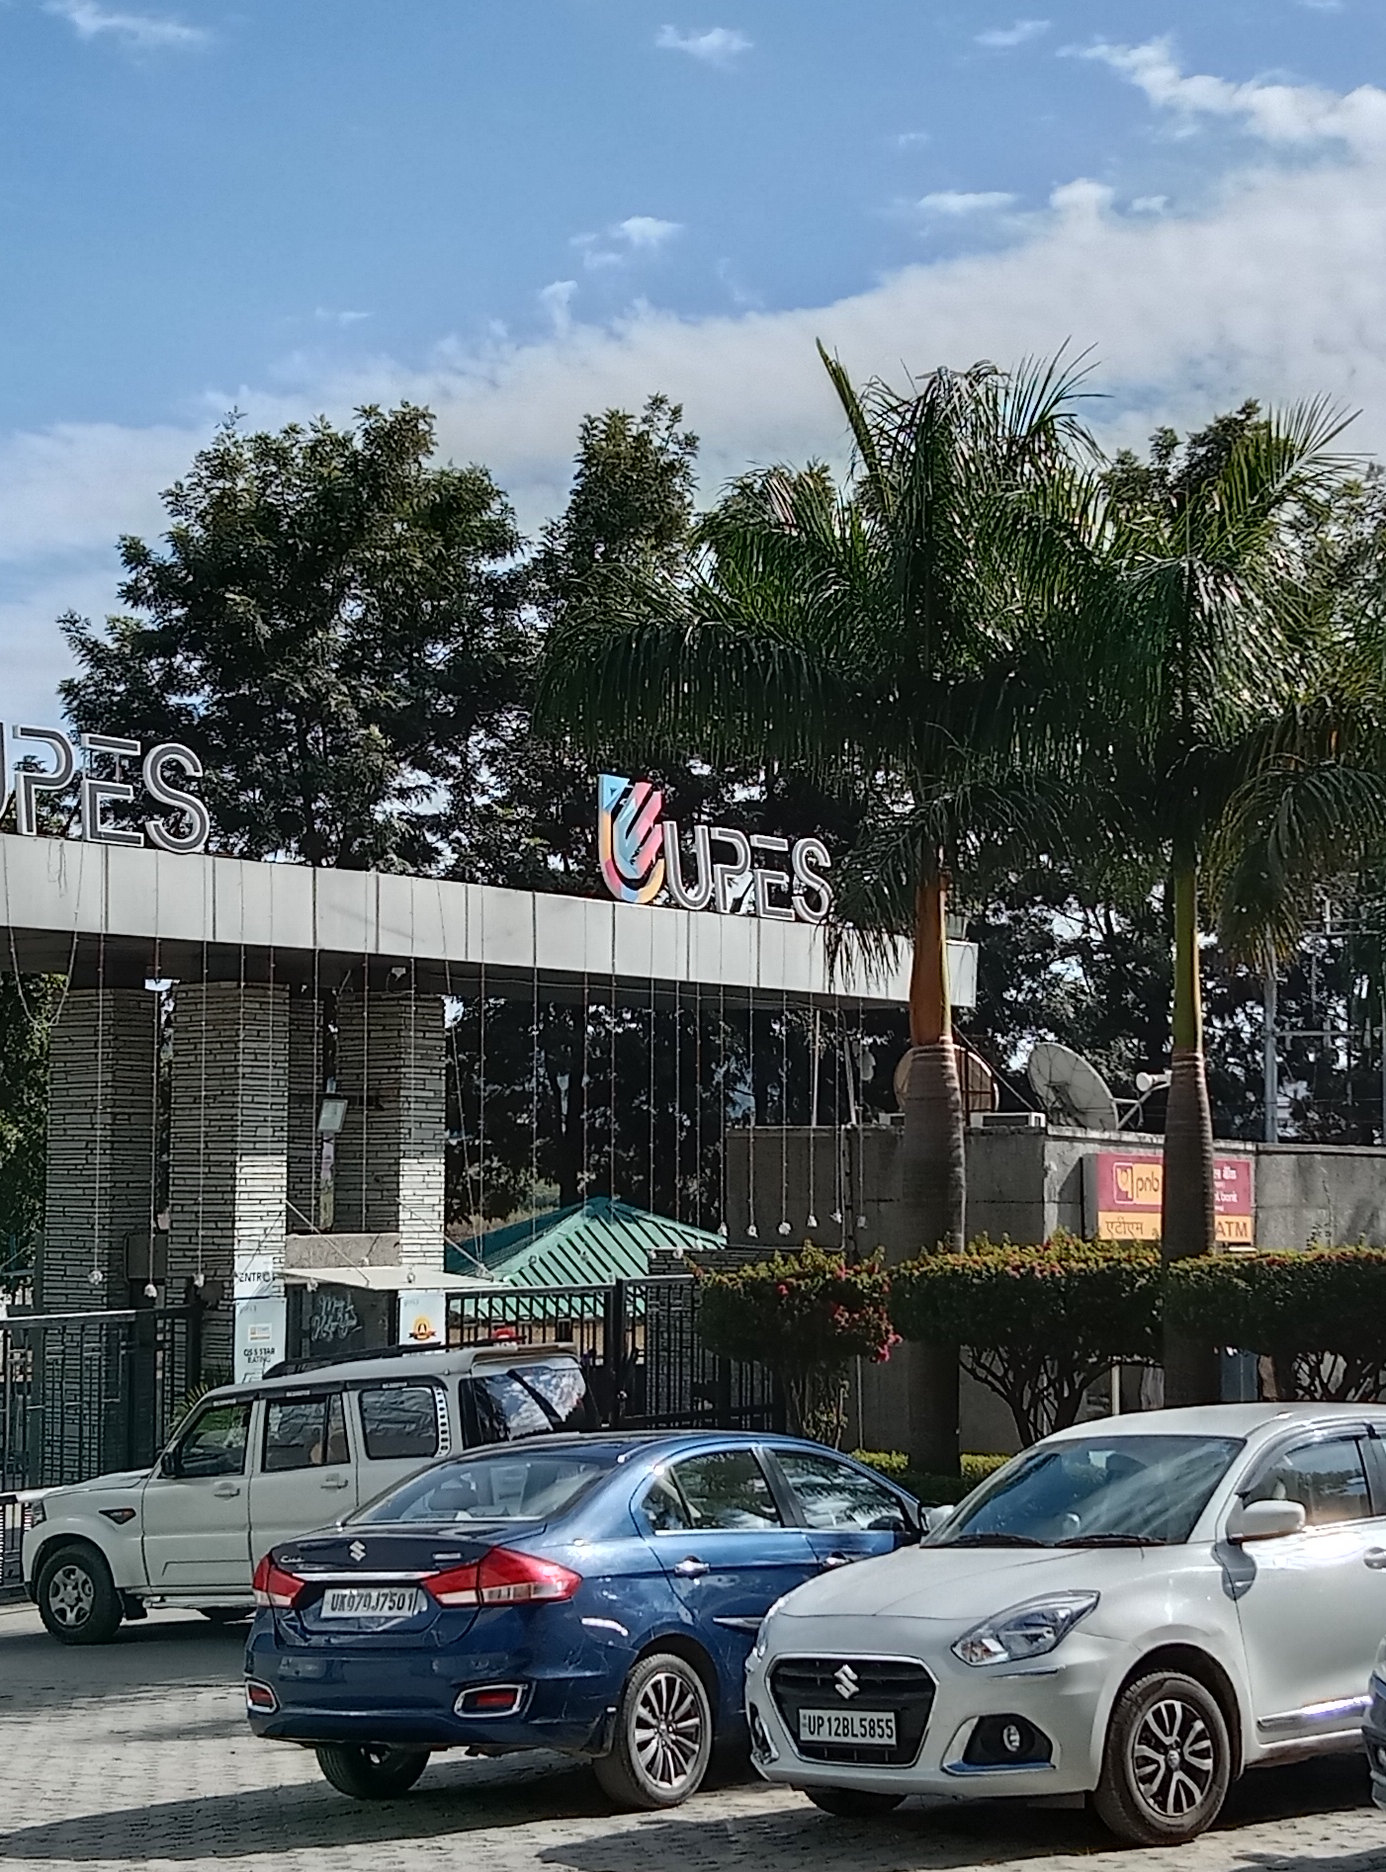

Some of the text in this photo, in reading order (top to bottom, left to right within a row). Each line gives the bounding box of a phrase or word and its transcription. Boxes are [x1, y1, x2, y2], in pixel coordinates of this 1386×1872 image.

[663, 820, 834, 924] UPES
[1136, 1172, 1160, 1198] pnb
[1215, 1221, 1248, 1238] ATM
[239, 1271, 271, 1283] ENTR
[807, 1717, 894, 1739] UP12BL5855
